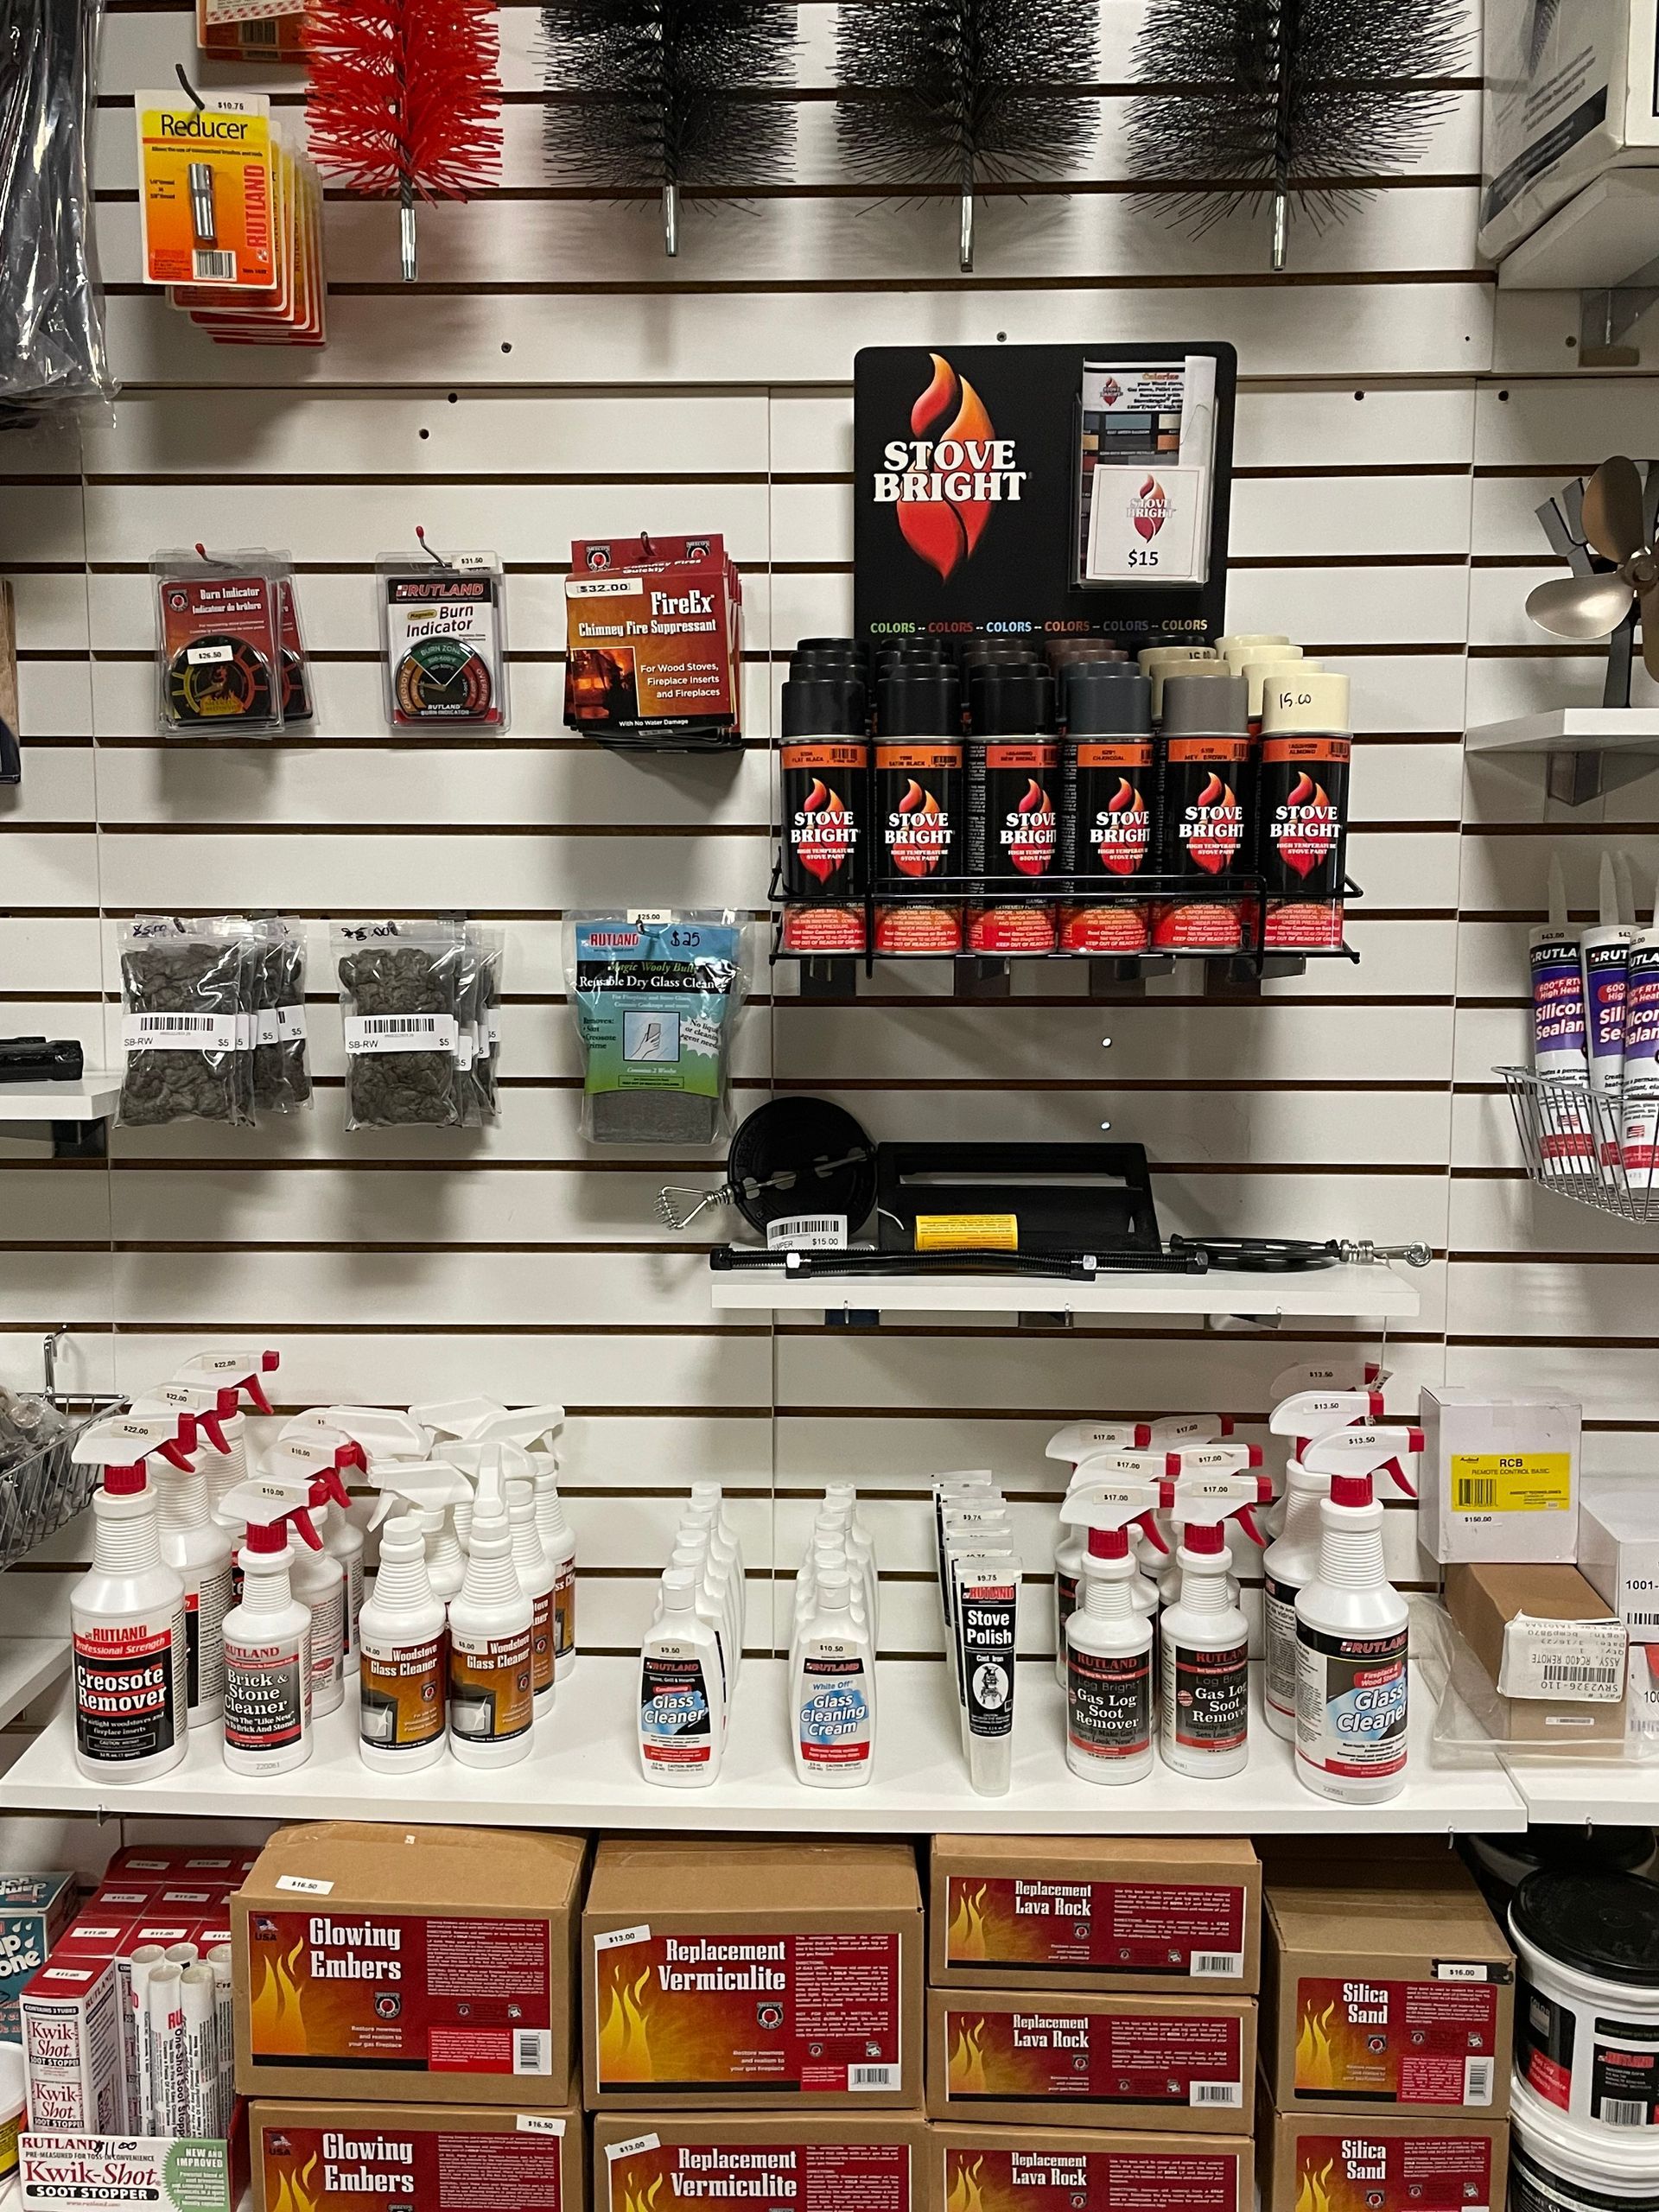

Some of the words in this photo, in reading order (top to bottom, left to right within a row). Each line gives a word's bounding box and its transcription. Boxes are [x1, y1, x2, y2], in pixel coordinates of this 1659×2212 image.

[162, 115, 248, 139] Reducer
[244, 164, 266, 248] RUTLAND
[883, 440, 1015, 472] STOVE
[874, 472, 1027, 502] BRIGHT
[1128, 550, 1158, 567] $15
[200, 589, 220, 600] Burn
[222, 588, 259, 598] Indicator
[408, 584, 483, 596] RUTLAND
[580, 583, 628, 593] $32.00
[651, 590, 712, 615] FireEx
[440, 607, 474, 619] Burn
[407, 620, 473, 637] Indicator
[579, 623, 623, 638] Chimney
[626, 621, 648, 635] Fire
[651, 620, 715, 634] Suppressant
[871, 622, 915, 634] COLORS
[928, 622, 973, 632] COLORS
[986, 621, 1031, 632] COLORS
[1045, 620, 1090, 632] COLORS
[1103, 620, 1148, 632] COLORS
[1161, 620, 1208, 631] COLORS
[658, 664, 684, 672] Wood
[687, 663, 719, 672] Stoves,
[647, 677, 688, 686] Fireplace
[690, 676, 719, 684] Inserts
[657, 690, 673, 698] and
[676, 688, 720, 698] Fireplaces
[794, 811, 854, 826] STOVE
[889, 813, 948, 827] STOVE
[1006, 813, 1056, 827] STOVE
[1096, 811, 1149, 825] STOVE
[1185, 806, 1243, 820] STOVE
[1275, 806, 1338, 819] STOVE
[791, 829, 859, 842] BRIGHT
[885, 830, 952, 844] BRIGHT
[1179, 823, 1244, 837] BRIGHT
[1270, 823, 1340, 837] BRIGHT
[590, 933, 639, 946] RUTLAND
[671, 931, 700, 947] $25
[609, 963, 638, 976] Magic
[642, 962, 671, 973] Wooly
[580, 976, 624, 988] Reusable
[627, 976, 648, 989] Dry
[651, 976, 679, 988] Glass
[1541, 989, 1558, 1000] High
[263, 1031, 273, 1040] $5
[291, 1027, 302, 1036] $5
[124, 1037, 153, 1047] SB-RW
[218, 1038, 228, 1047] $5
[349, 1039, 378, 1048] SB-RW
[439, 1038, 449, 1046] $5
[167, 1393, 187, 1402] $22.00
[124, 1426, 149, 1435] $22.00
[1500, 1459, 1522, 1467] RCB
[969, 1586, 1014, 1599] RUTLAND
[968, 1610, 1009, 1626] Stove
[92, 1625, 147, 1642] RUTLAND
[967, 1628, 1012, 1645] Polish
[76, 1639, 123, 1655] Professional
[125, 1637, 165, 1654] Strength
[491, 1635, 530, 1654] Woodstove
[392, 1644, 437, 1662] Woodstove
[467, 1655, 494, 1669] Glass
[498, 1648, 530, 1669] Cleaner
[1532, 1654, 1561, 1664] REMOTE
[1566, 1656, 1591, 1665] RC400
[371, 1662, 397, 1676] Glass
[400, 1657, 437, 1676] Cleaner
[652, 1662, 699, 1672] RUTLAND
[813, 1662, 859, 1671] RUTLAND
[1078, 1654, 1138, 1669] RUTLAND
[78, 1665, 163, 1692] Creosote
[227, 1669, 273, 1687] Brick
[277, 1674, 289, 1683] &
[813, 1681, 836, 1690] White
[837, 1681, 850, 1689] Off
[1361, 1678, 1382, 1687] Wood
[229, 1685, 280, 1701] Stone
[1195, 1688, 1224, 1700] Gas
[1230, 1682, 1248, 1698] Log
[1541, 1681, 1618, 1692] SRV2326-110
[79, 1686, 166, 1712] Remover
[225, 1695, 288, 1715] Cleaner
[653, 1694, 693, 1709] Glass
[813, 1694, 853, 1708] Glass
[1077, 1688, 1104, 1706] Gas
[1109, 1694, 1137, 1707] Log
[1210, 1697, 1239, 1713] Soot
[1355, 1684, 1403, 1710] Glass
[645, 1707, 705, 1726] Cleaner
[800, 1704, 865, 1722] Cleaning
[1076, 1710, 1139, 1729] Remover
[1089, 1704, 1123, 1719] Soot
[1338, 1704, 1407, 1732] Cleaner
[255, 1722, 272, 1732] And
[809, 1720, 856, 1737] Cream
[1015, 1880, 1091, 1898] Replacement
[1015, 1897, 1049, 1916] Lava
[1054, 1899, 1091, 1916] Rock
[309, 1917, 401, 1951] Glowing
[609, 1933, 635, 1943] $13.00
[666, 1939, 785, 1964] Replacement
[310, 1951, 402, 1980] Embers
[658, 1965, 785, 1991] Vermiculite
[1343, 1983, 1389, 2004] Silica
[24, 2005, 52, 2013] CONTAINS
[1348, 2004, 1388, 2024] Sand
[31, 2021, 75, 2040] Kwik-
[1013, 2014, 1089, 2031] Replacement
[1014, 2030, 1047, 2048] Lava
[1052, 2031, 1089, 2049] Rock
[37, 2040, 70, 2057] Shot
[35, 2083, 80, 2102] Kwik-
[42, 2101, 73, 2120] Shot
[22, 2137, 100, 2151] RUTLAND
[322, 2133, 413, 2164] Glowing
[620, 2141, 645, 2153] $13.00
[1341, 2139, 1386, 2160] Silica
[186, 2148, 206, 2157] NEW
[678, 2148, 797, 2171] Replacement
[1012, 2152, 1087, 2169] Replacement
[177, 2158, 222, 2167] IMPROVED
[1346, 2160, 1386, 2180] Sand
[24, 2160, 157, 2186] Kwik-Shot
[324, 2164, 414, 2193] Embers
[1012, 2168, 1046, 2185] Lava
[1050, 2169, 1087, 2186] Rock
[671, 2172, 797, 2197] Vermiculite
[36, 2187, 79, 2197] SOOT
[81, 2187, 147, 2199] STOPPER
